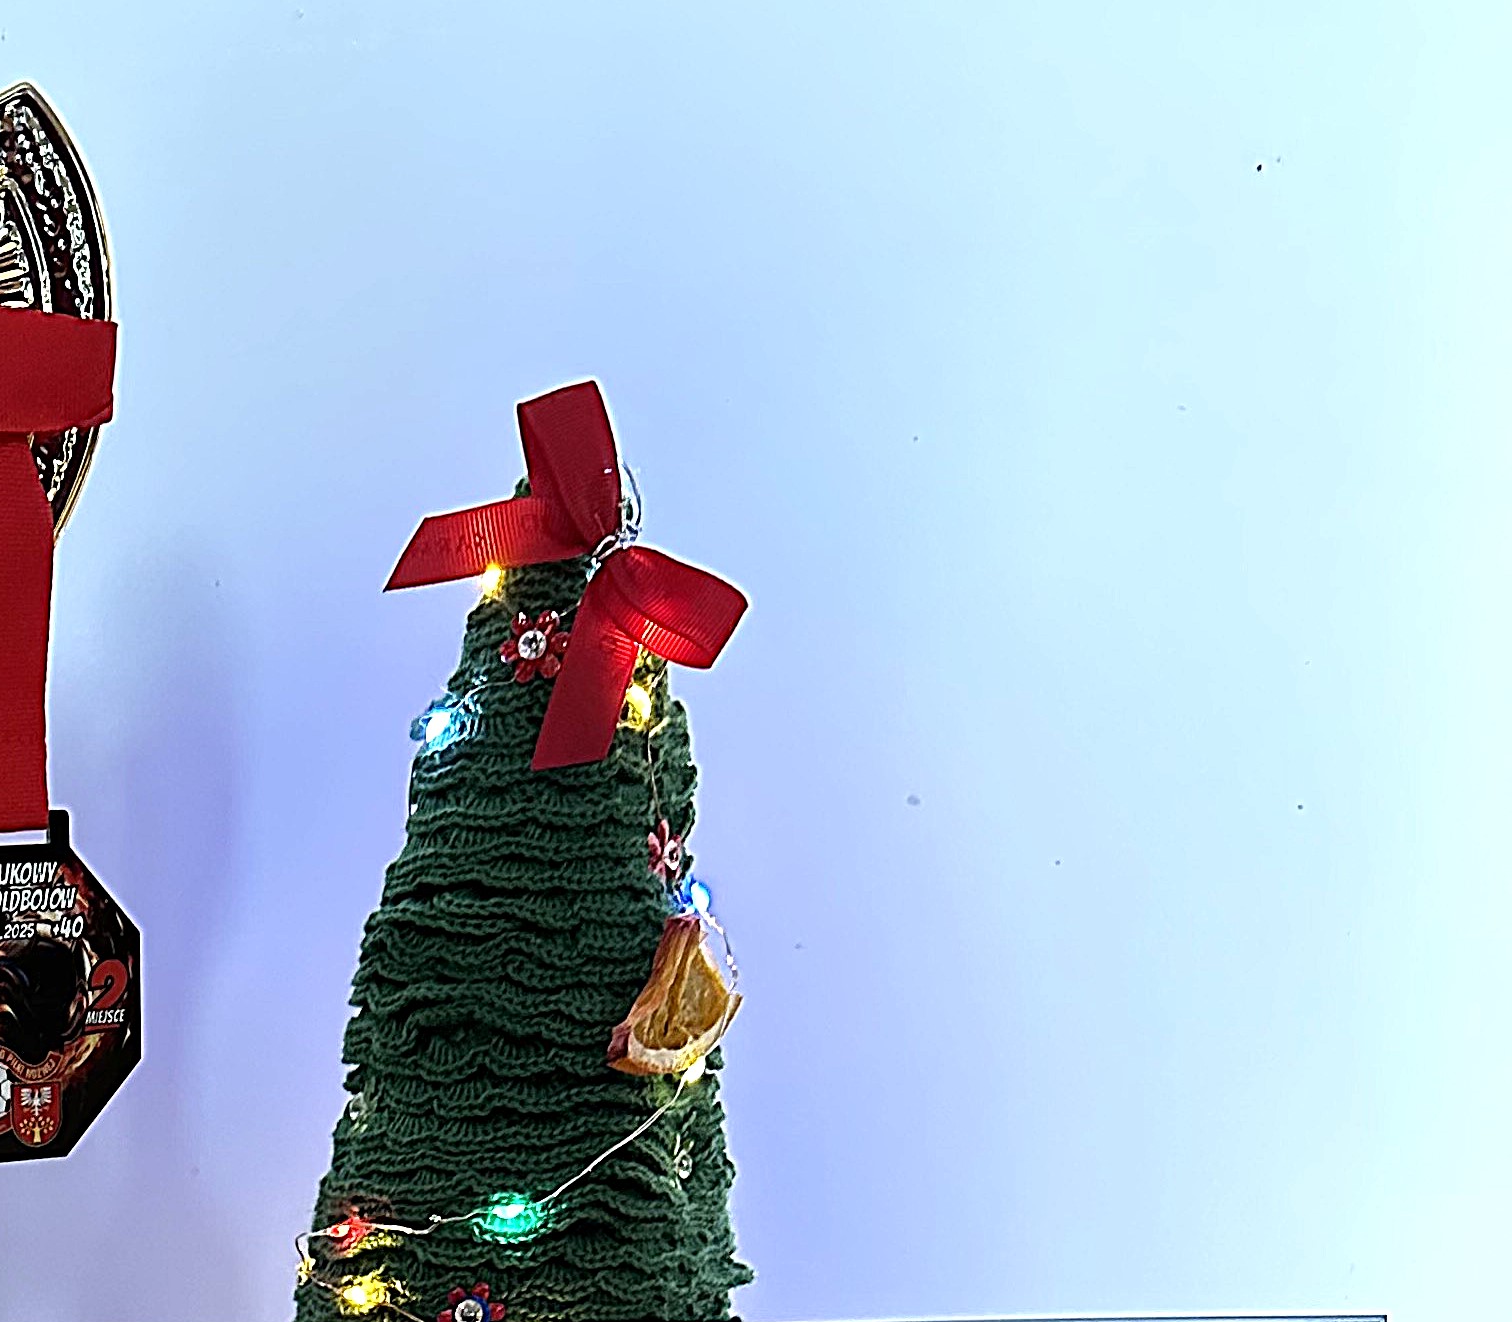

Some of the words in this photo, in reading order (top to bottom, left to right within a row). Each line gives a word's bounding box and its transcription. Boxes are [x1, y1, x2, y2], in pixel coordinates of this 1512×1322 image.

[53, 916, 84, 938] +40
[91, 958, 128, 1010] 2
[85, 1009, 125, 1025] MIEJSCE
